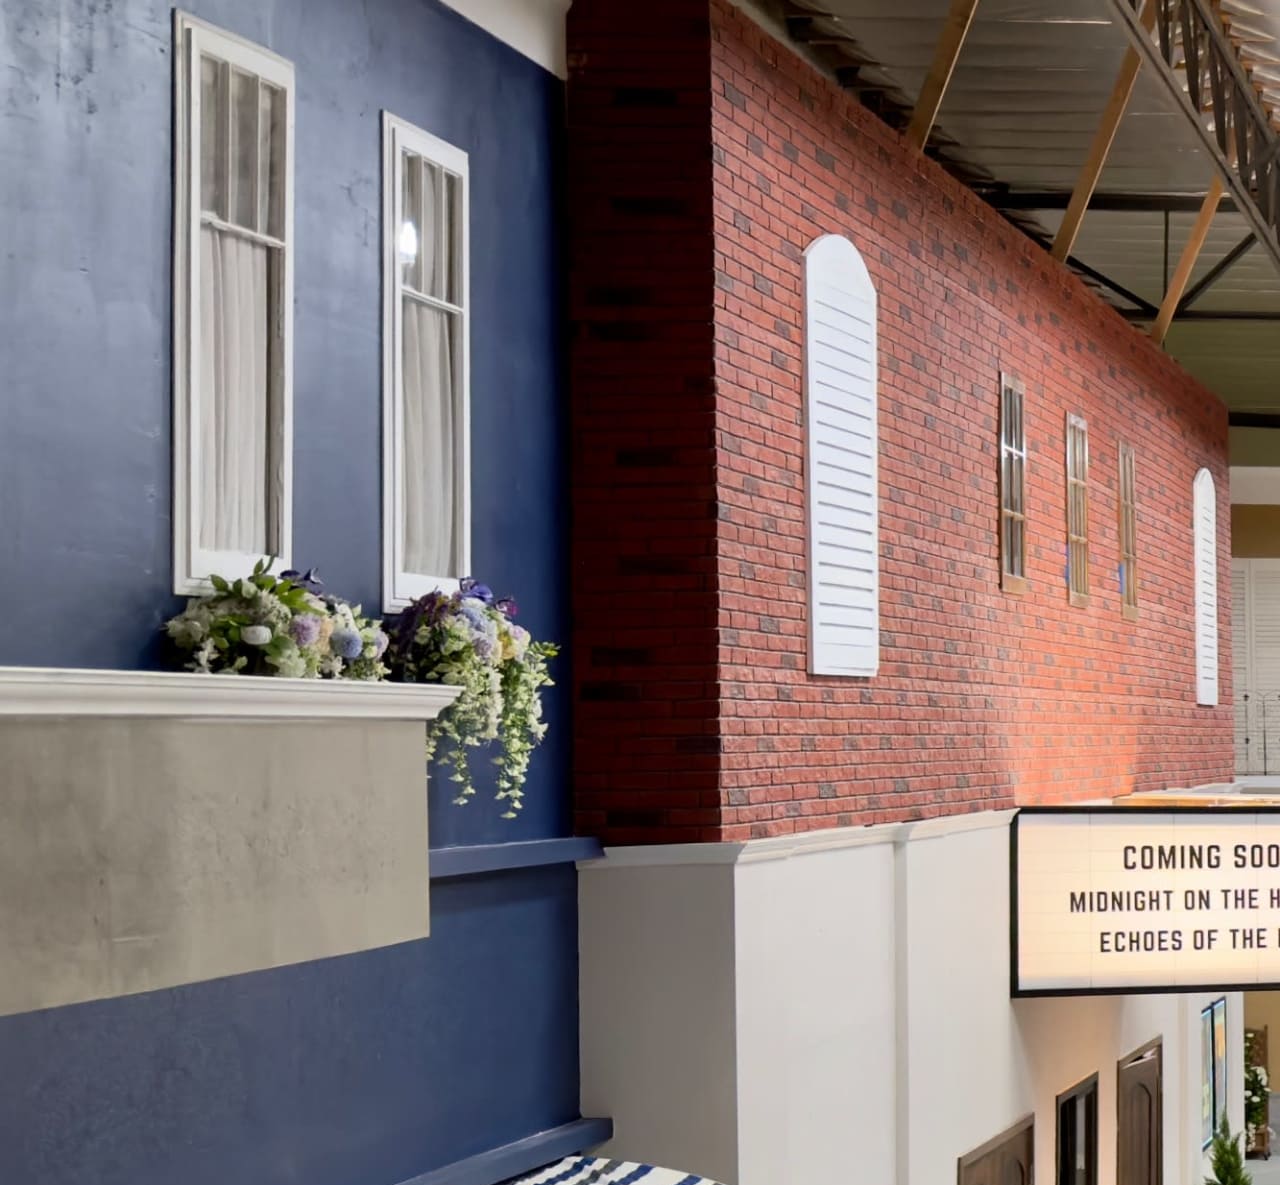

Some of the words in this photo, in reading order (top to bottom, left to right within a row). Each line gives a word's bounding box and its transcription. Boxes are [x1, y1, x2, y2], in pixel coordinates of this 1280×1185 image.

[1123, 844, 1222, 870] COMING
[1069, 890, 1174, 913] MIDNIGHT
[1184, 889, 1211, 911] ON
[1221, 888, 1260, 910] THE
[1099, 930, 1183, 953] ECHOES
[1193, 929, 1218, 950] OF
[1230, 928, 1268, 949] THE
